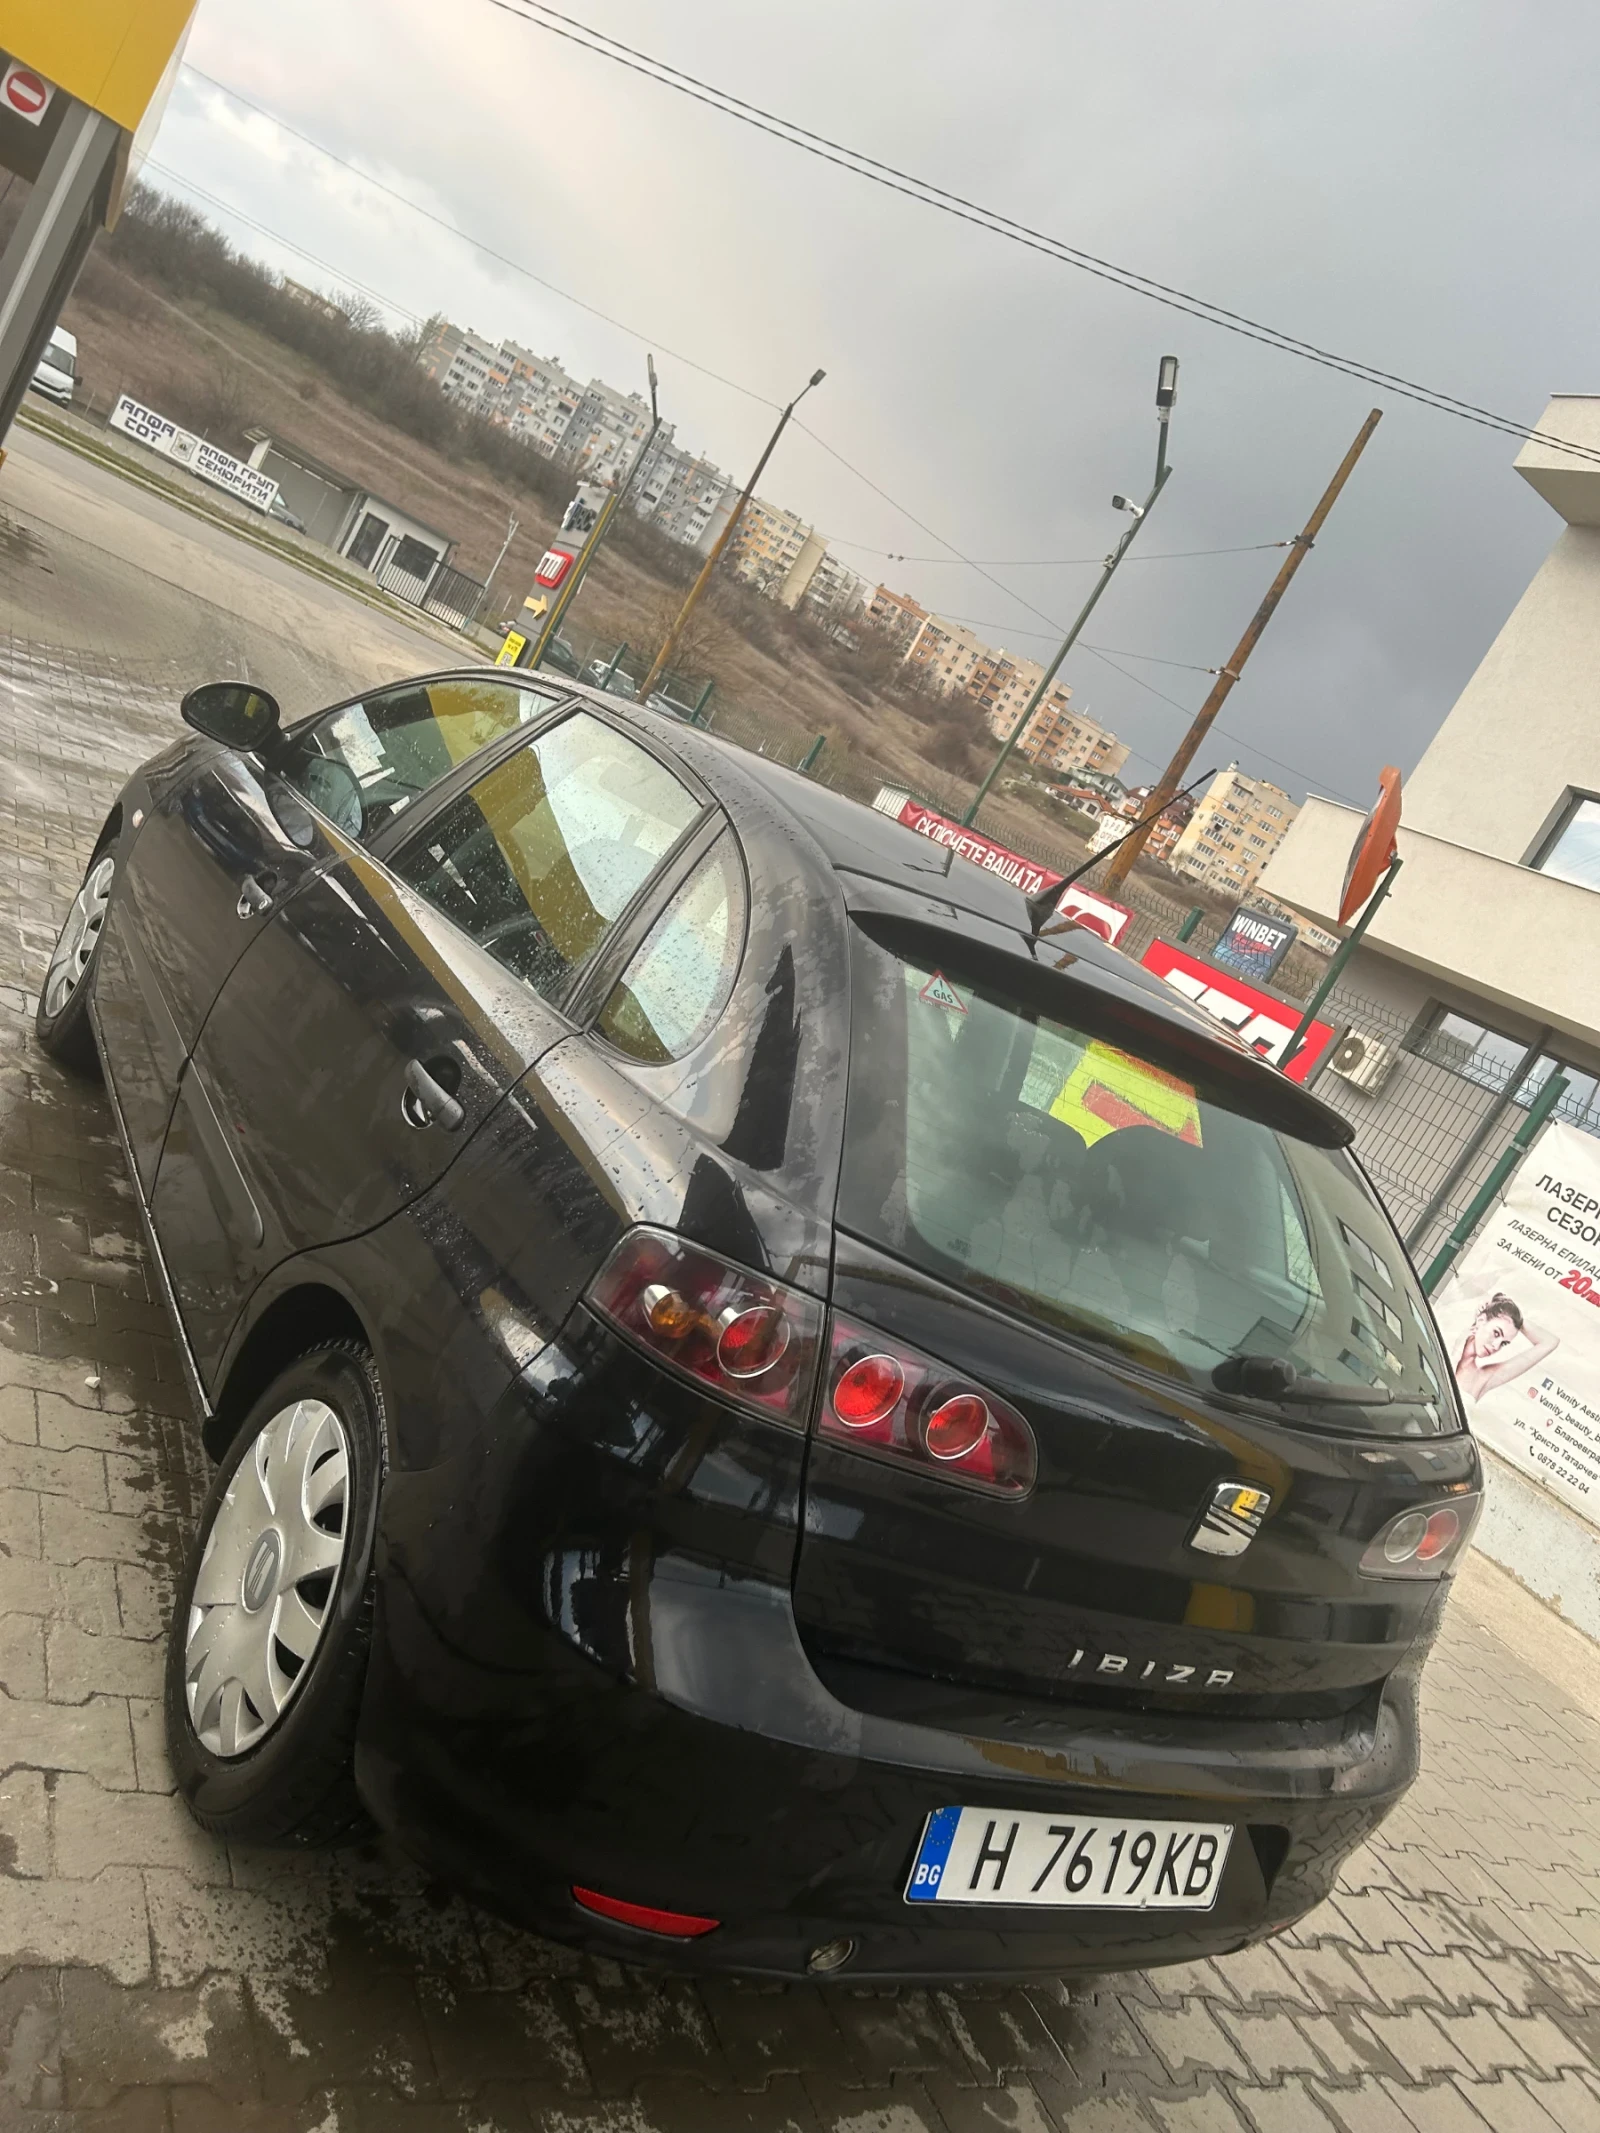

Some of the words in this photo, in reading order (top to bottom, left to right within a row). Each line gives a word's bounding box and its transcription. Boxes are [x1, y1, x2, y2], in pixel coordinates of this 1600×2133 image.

[124, 417, 161, 443] СОТ
[197, 455, 269, 501] СЕКЮРИТИ
[240, 467, 275, 493] ГРУП
[914, 816, 987, 863] СКЛЮЧЕТЕ
[983, 850, 1044, 895] ВАШАТА
[1231, 914, 1287, 950] WINBET
[933, 989, 954, 1004] GAS
[1507, 1219, 1558, 1252] ЛАЗЕРНА
[1497, 1238, 1513, 1252] ЗА
[1511, 1247, 1546, 1271] ЖЕНИ
[1544, 1266, 1563, 1280] ОТ
[1556, 1386, 1580, 1409] Vanity
[1513, 1418, 1526, 1430] ул.
[1537, 1452, 1557, 1470] 0878
[1555, 1466, 1568, 1479] 22
[1566, 1474, 1579, 1487] 22
[1578, 1482, 1590, 1495] 04
[1067, 1649, 1234, 1687] IBIZA
[914, 1863, 941, 1886] BG
